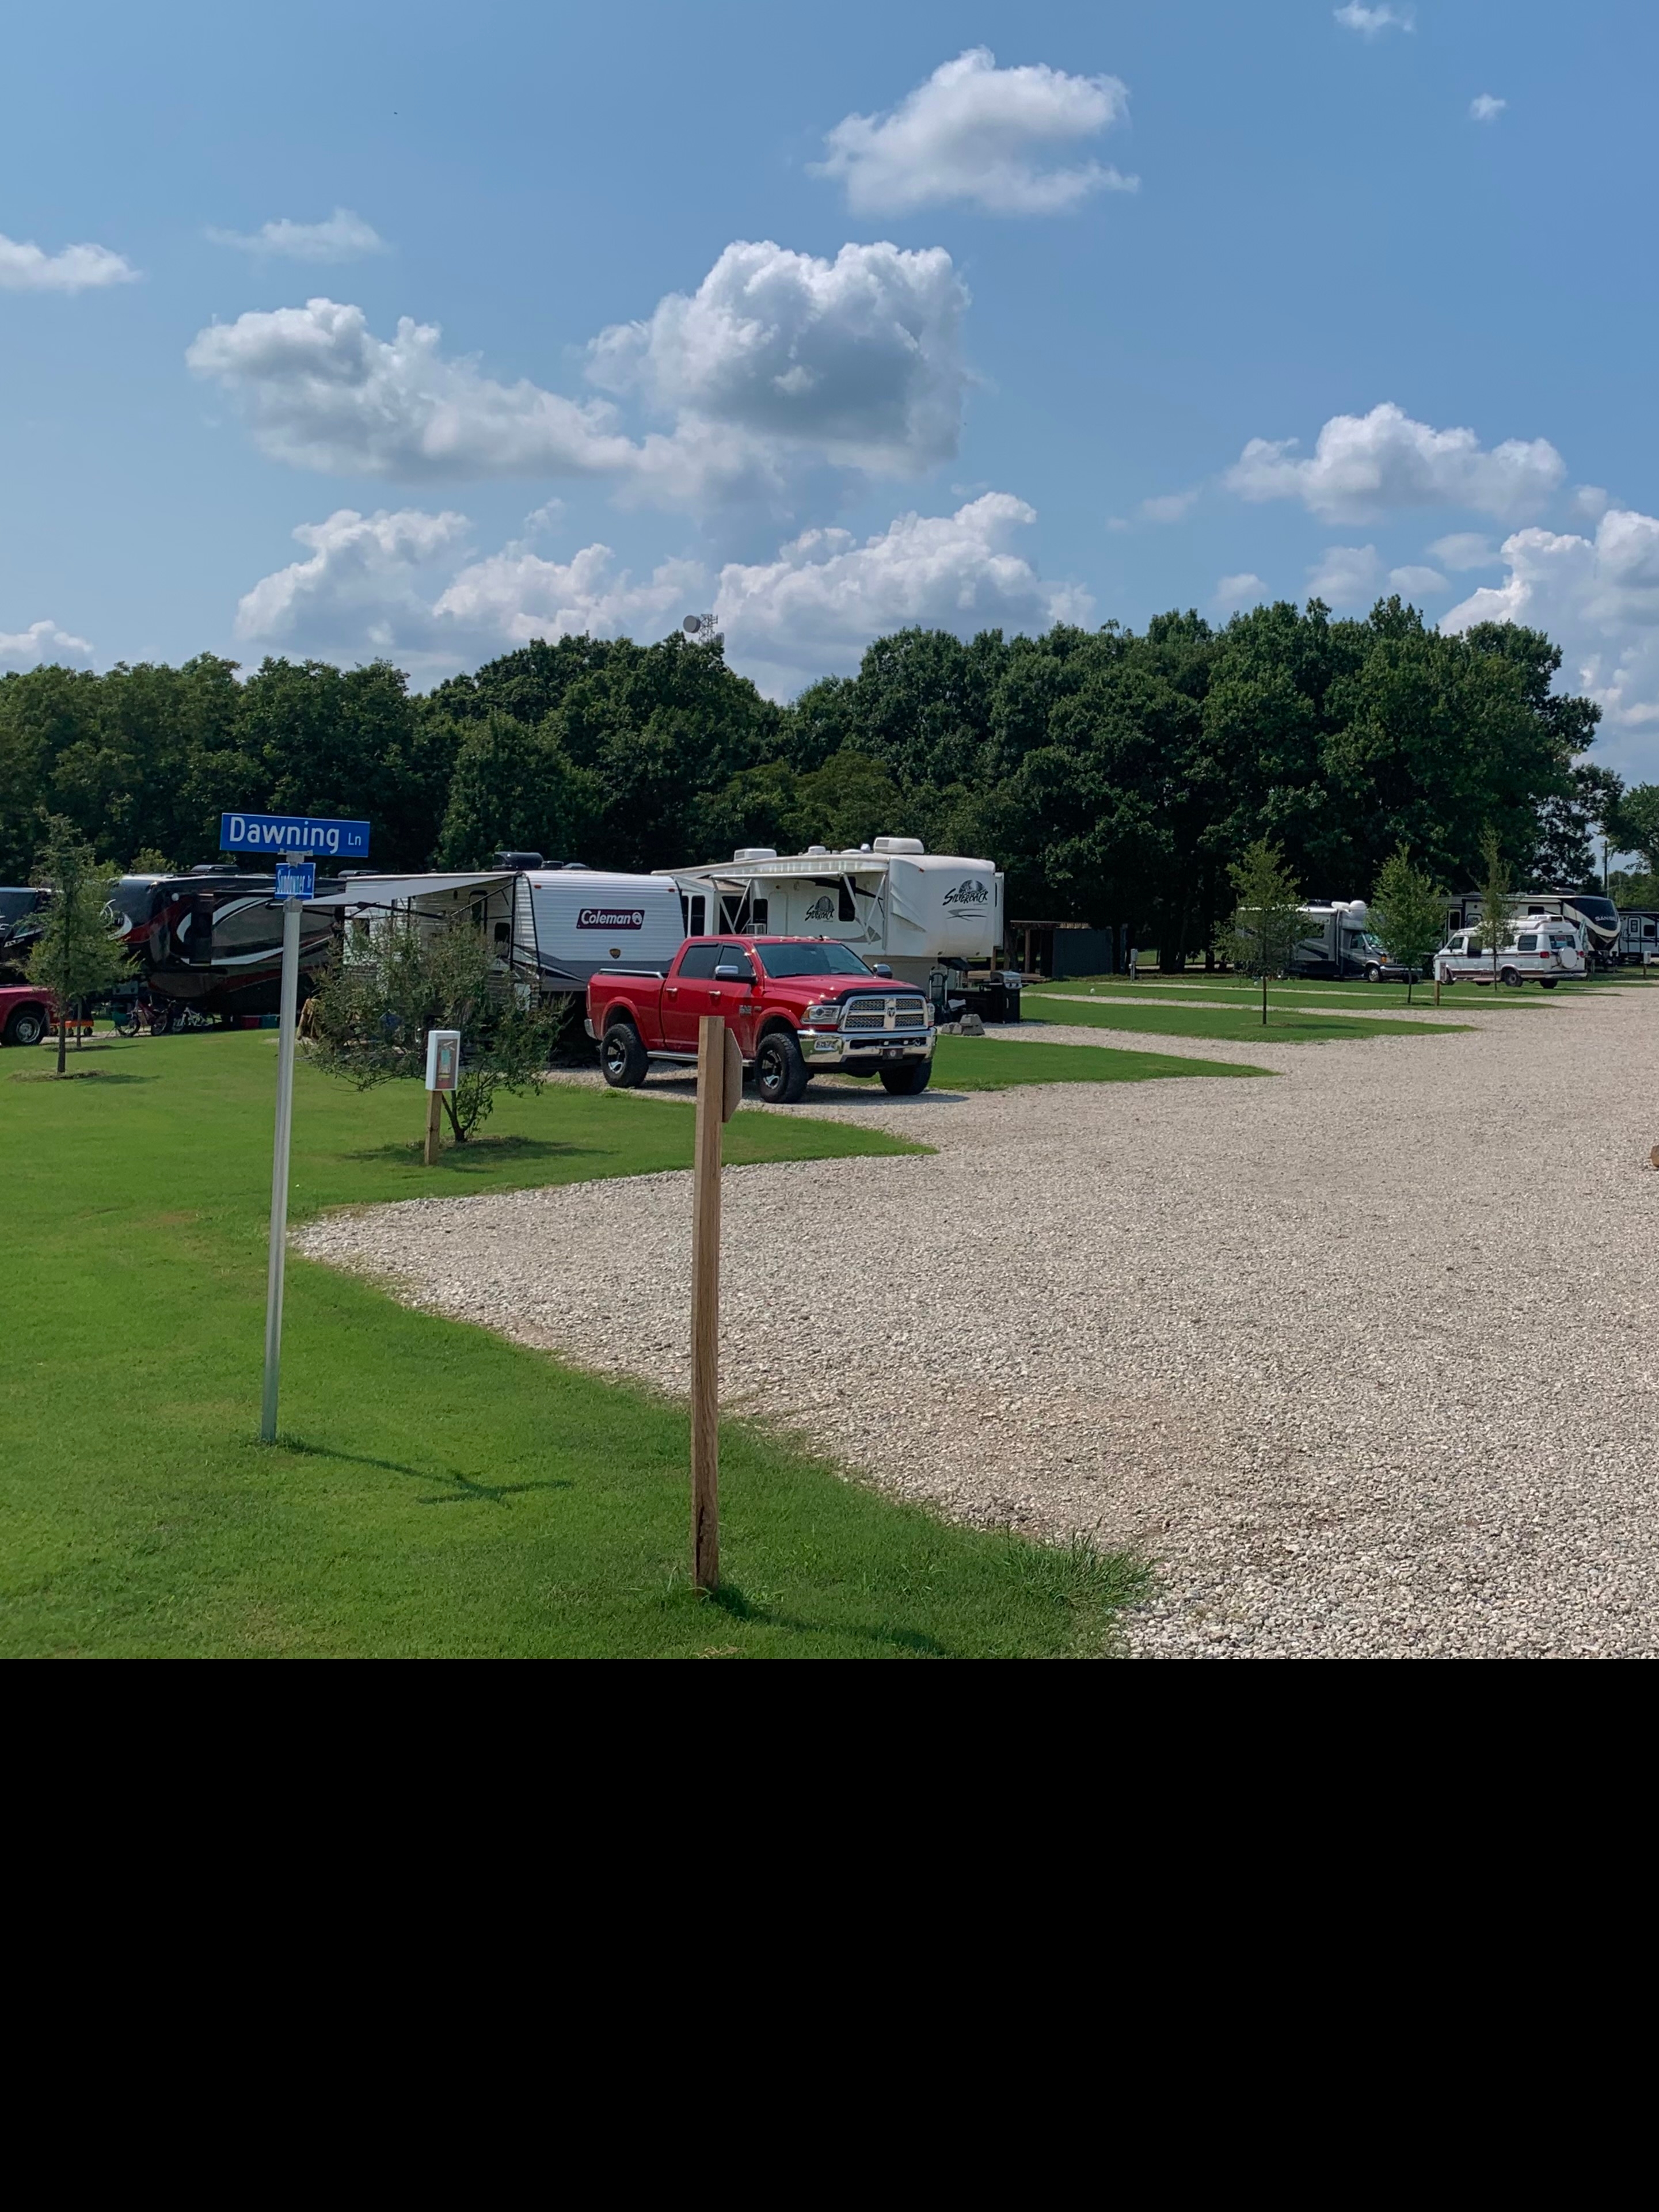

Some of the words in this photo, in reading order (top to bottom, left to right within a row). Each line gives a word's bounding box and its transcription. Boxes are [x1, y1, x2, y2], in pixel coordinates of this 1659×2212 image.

[230, 816, 340, 855] Dawning
[348, 832, 362, 846] Ln
[581, 910, 631, 925] Coleman
